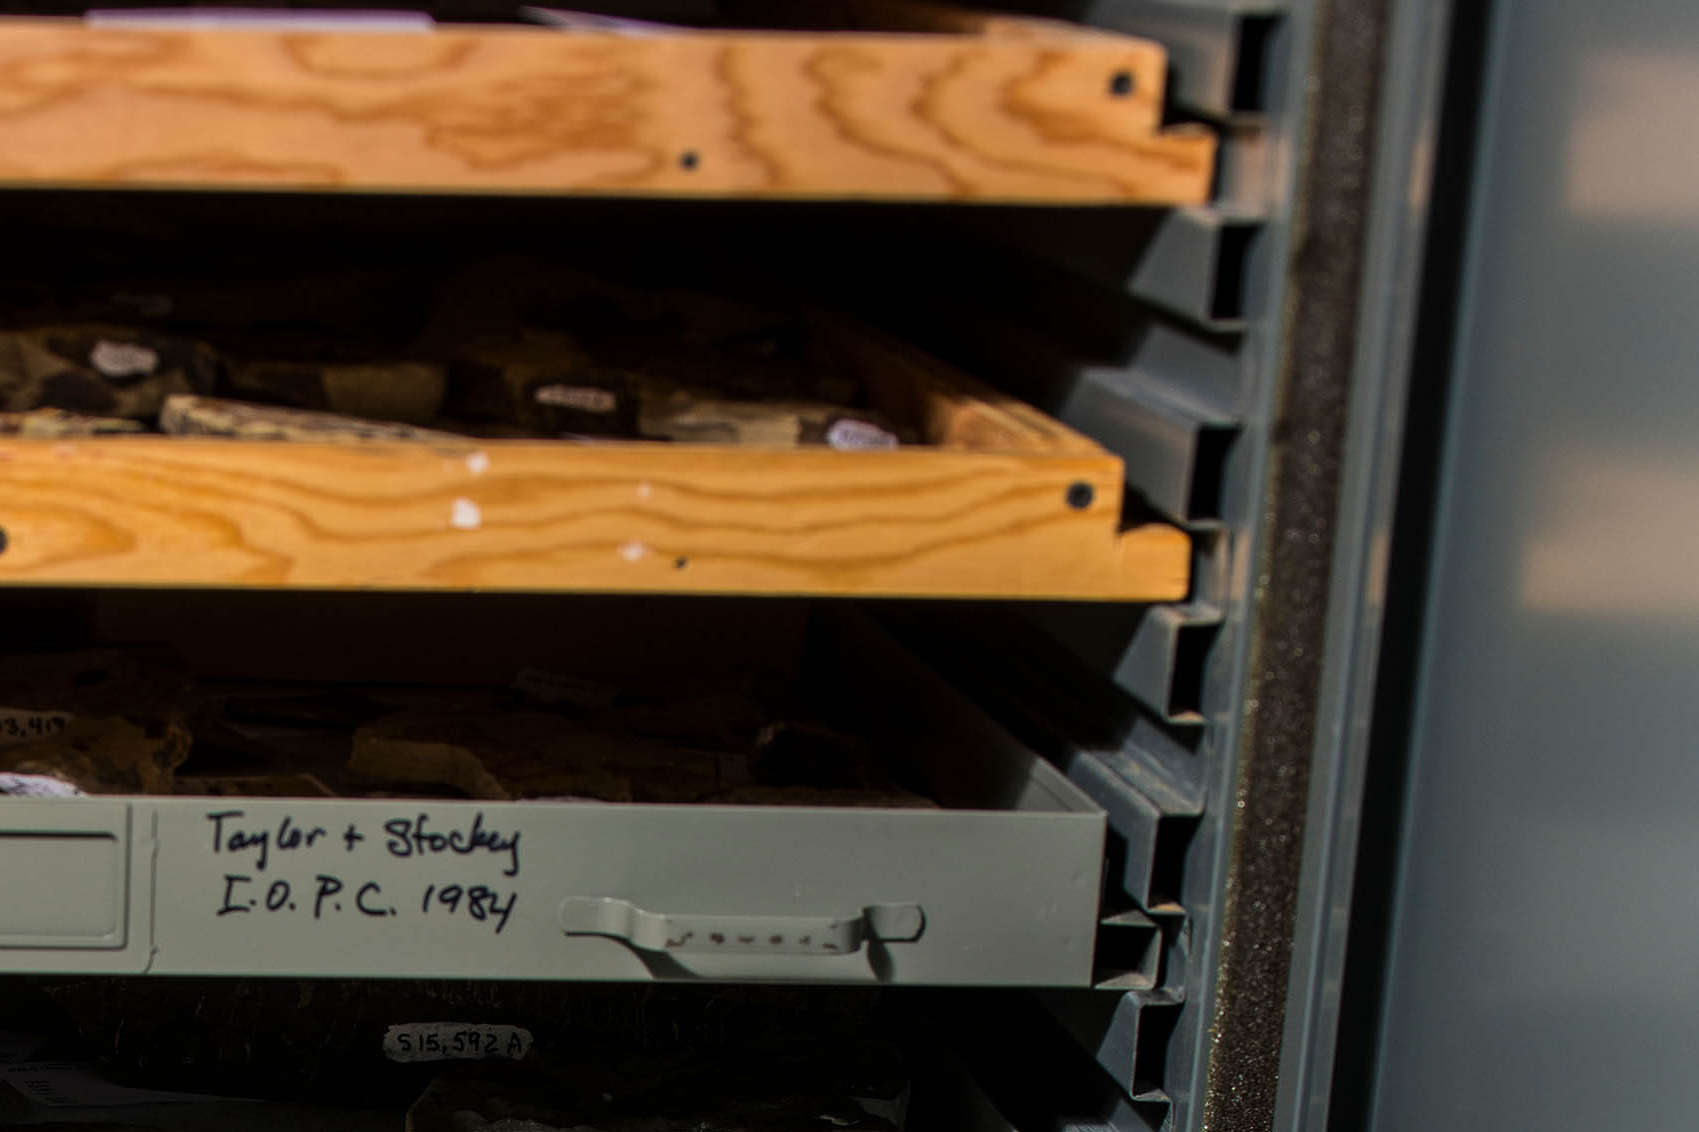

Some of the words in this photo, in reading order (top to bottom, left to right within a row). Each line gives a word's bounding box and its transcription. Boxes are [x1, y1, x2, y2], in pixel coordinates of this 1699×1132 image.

[206, 810, 327, 871] Taylor
[344, 823, 365, 852] +
[384, 812, 521, 877] Stockey
[422, 882, 518, 934] 1984
